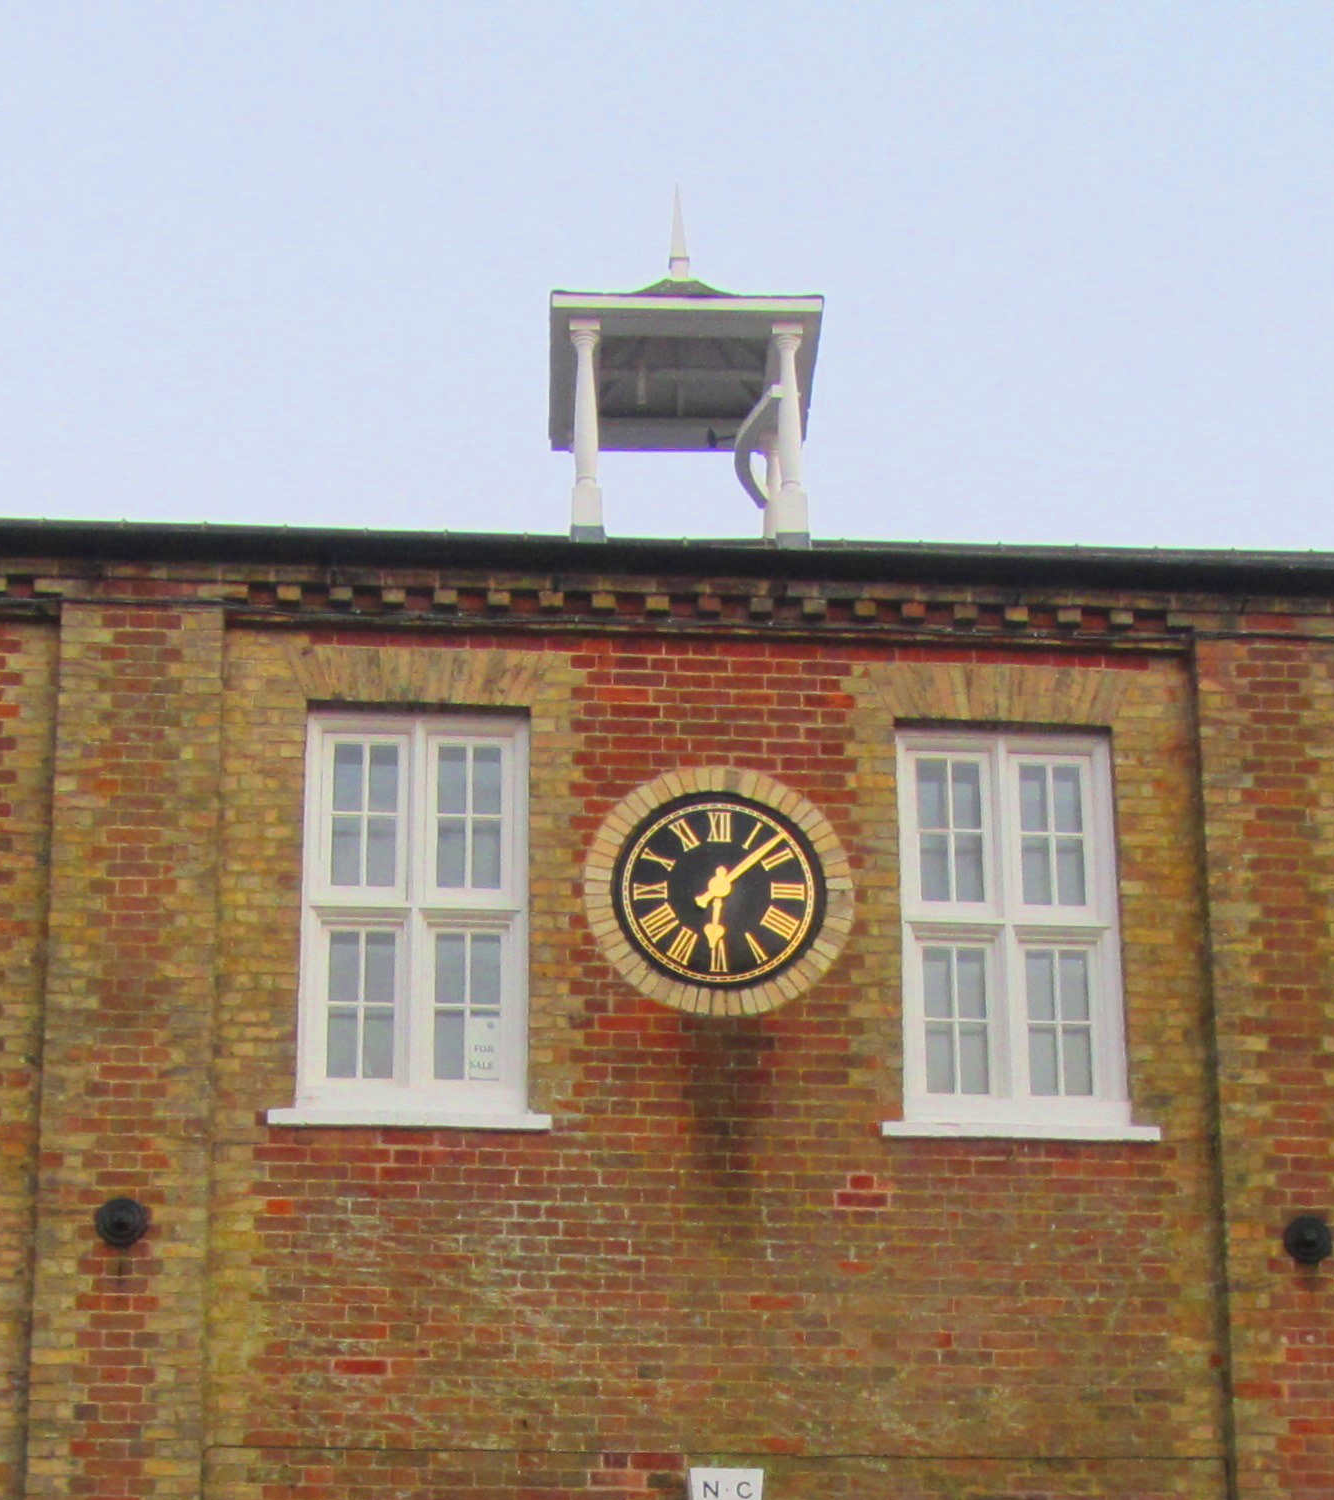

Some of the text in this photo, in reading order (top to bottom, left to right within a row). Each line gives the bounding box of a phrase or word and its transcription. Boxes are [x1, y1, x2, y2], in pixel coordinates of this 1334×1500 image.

[668, 818, 700, 852] XI
[706, 812, 732, 842] XII
[742, 821, 763, 850] I
[640, 847, 676, 871] X
[761, 847, 794, 871] II
[633, 881, 667, 900] IX
[770, 882, 805, 900] III
[639, 902, 679, 944] VIII
[667, 926, 698, 966] VII
[744, 932, 768, 964] V
